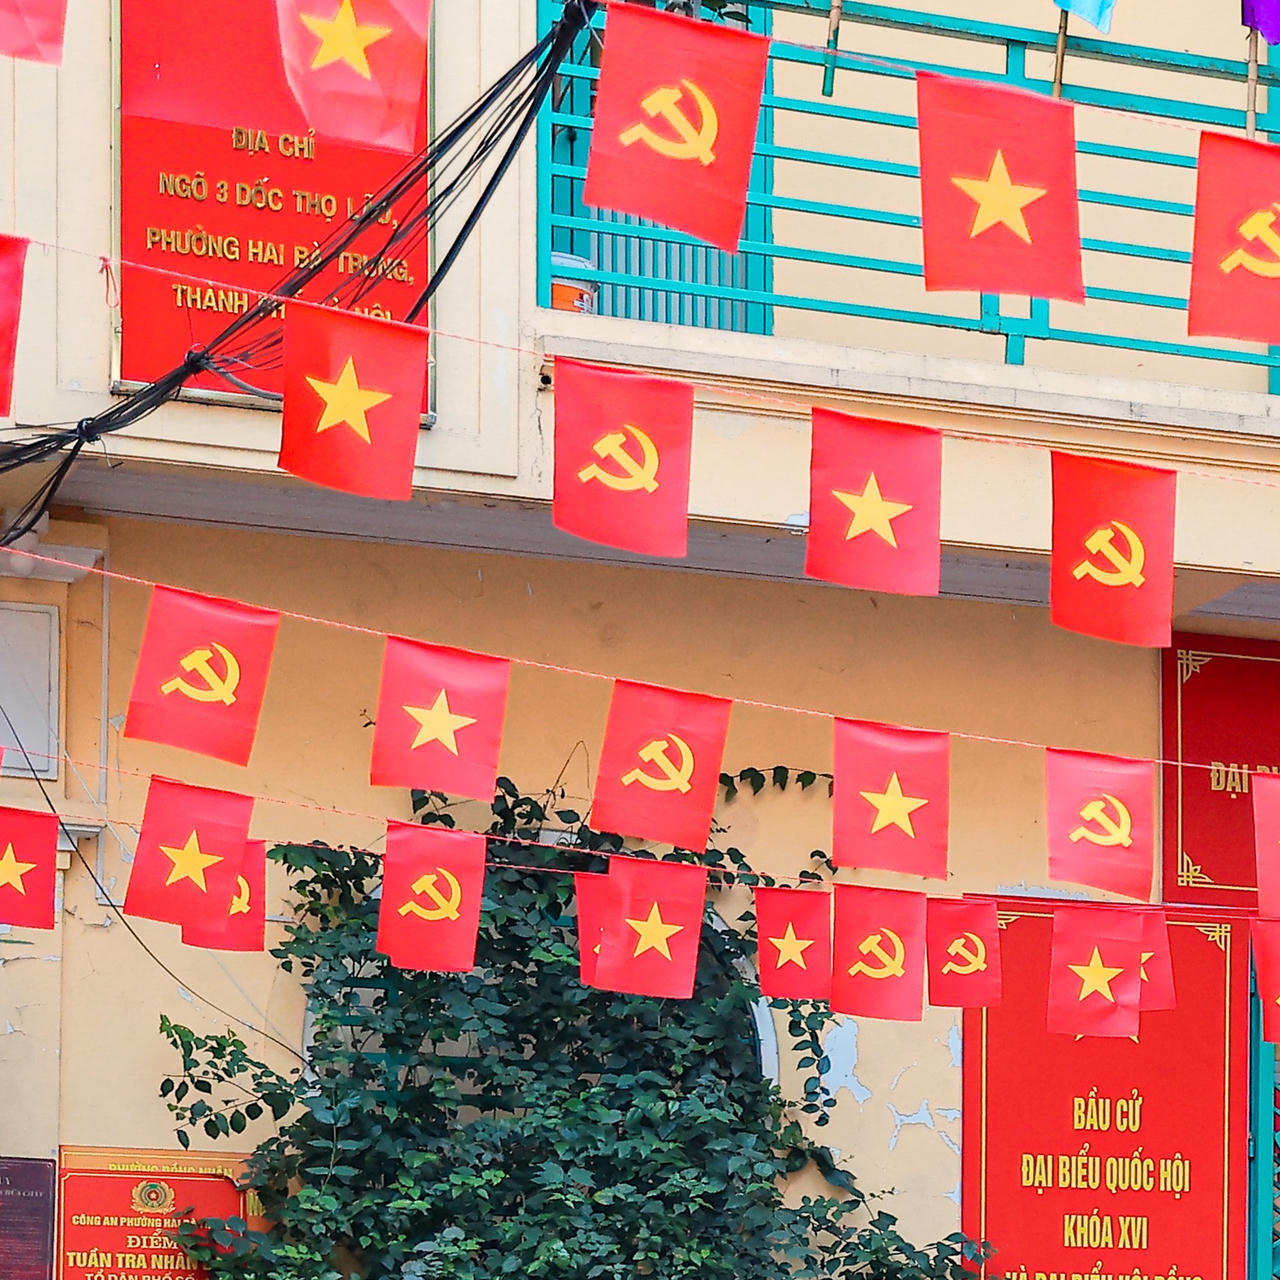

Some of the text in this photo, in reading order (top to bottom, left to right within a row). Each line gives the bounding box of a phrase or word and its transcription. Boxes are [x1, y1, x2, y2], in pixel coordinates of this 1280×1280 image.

[232, 127, 316, 160] ĐỊA CHỈ
[159, 171, 208, 202] NGÕ
[216, 181, 229, 203] 3
[236, 177, 283, 211] DỐC
[292, 190, 337, 223] THỌ
[146, 224, 240, 261] PHƯỜNG
[248, 239, 285, 265] HAI
[172, 282, 249, 314] THÀNH
[1210, 761, 1249, 799] ĐẠI
[1073, 1086, 1143, 1132] BẦU CỬ
[1021, 1143, 1191, 1199] ĐẠI BIỂU QUỐC HỘI
[72, 1213, 102, 1226] CÔNG
[103, 1215, 119, 1227] AN
[120, 1214, 162, 1229] PHƯỜNG
[163, 1217, 181, 1229] HAI
[127, 1228, 179, 1250] ĐIỂM
[1063, 1208, 1149, 1250] KHÓA XVI
[66, 1247, 198, 1271] TUẦN TRA NHÂN
